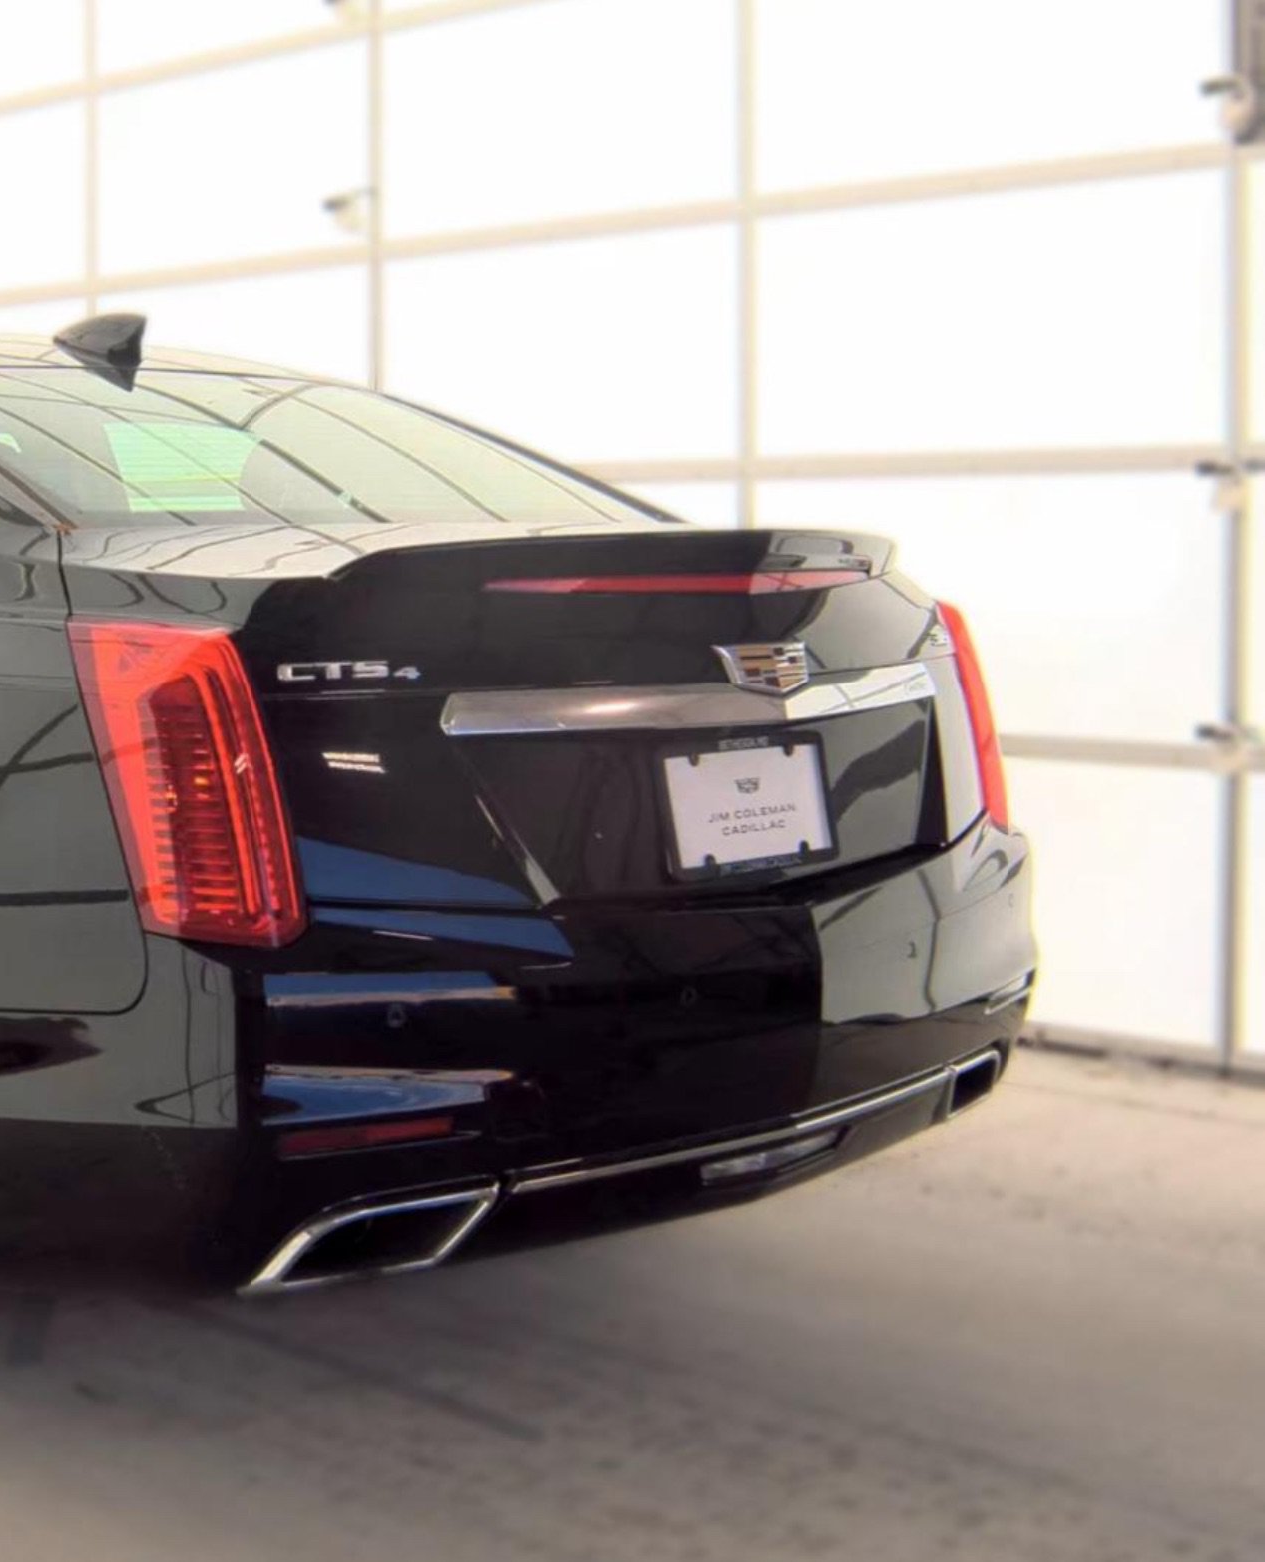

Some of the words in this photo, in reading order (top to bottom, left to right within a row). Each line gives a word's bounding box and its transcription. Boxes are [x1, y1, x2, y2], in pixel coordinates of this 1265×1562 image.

[708, 811, 730, 823] JIM
[734, 803, 796, 820] COLEMAN
[722, 820, 786, 836] CADILLAC
